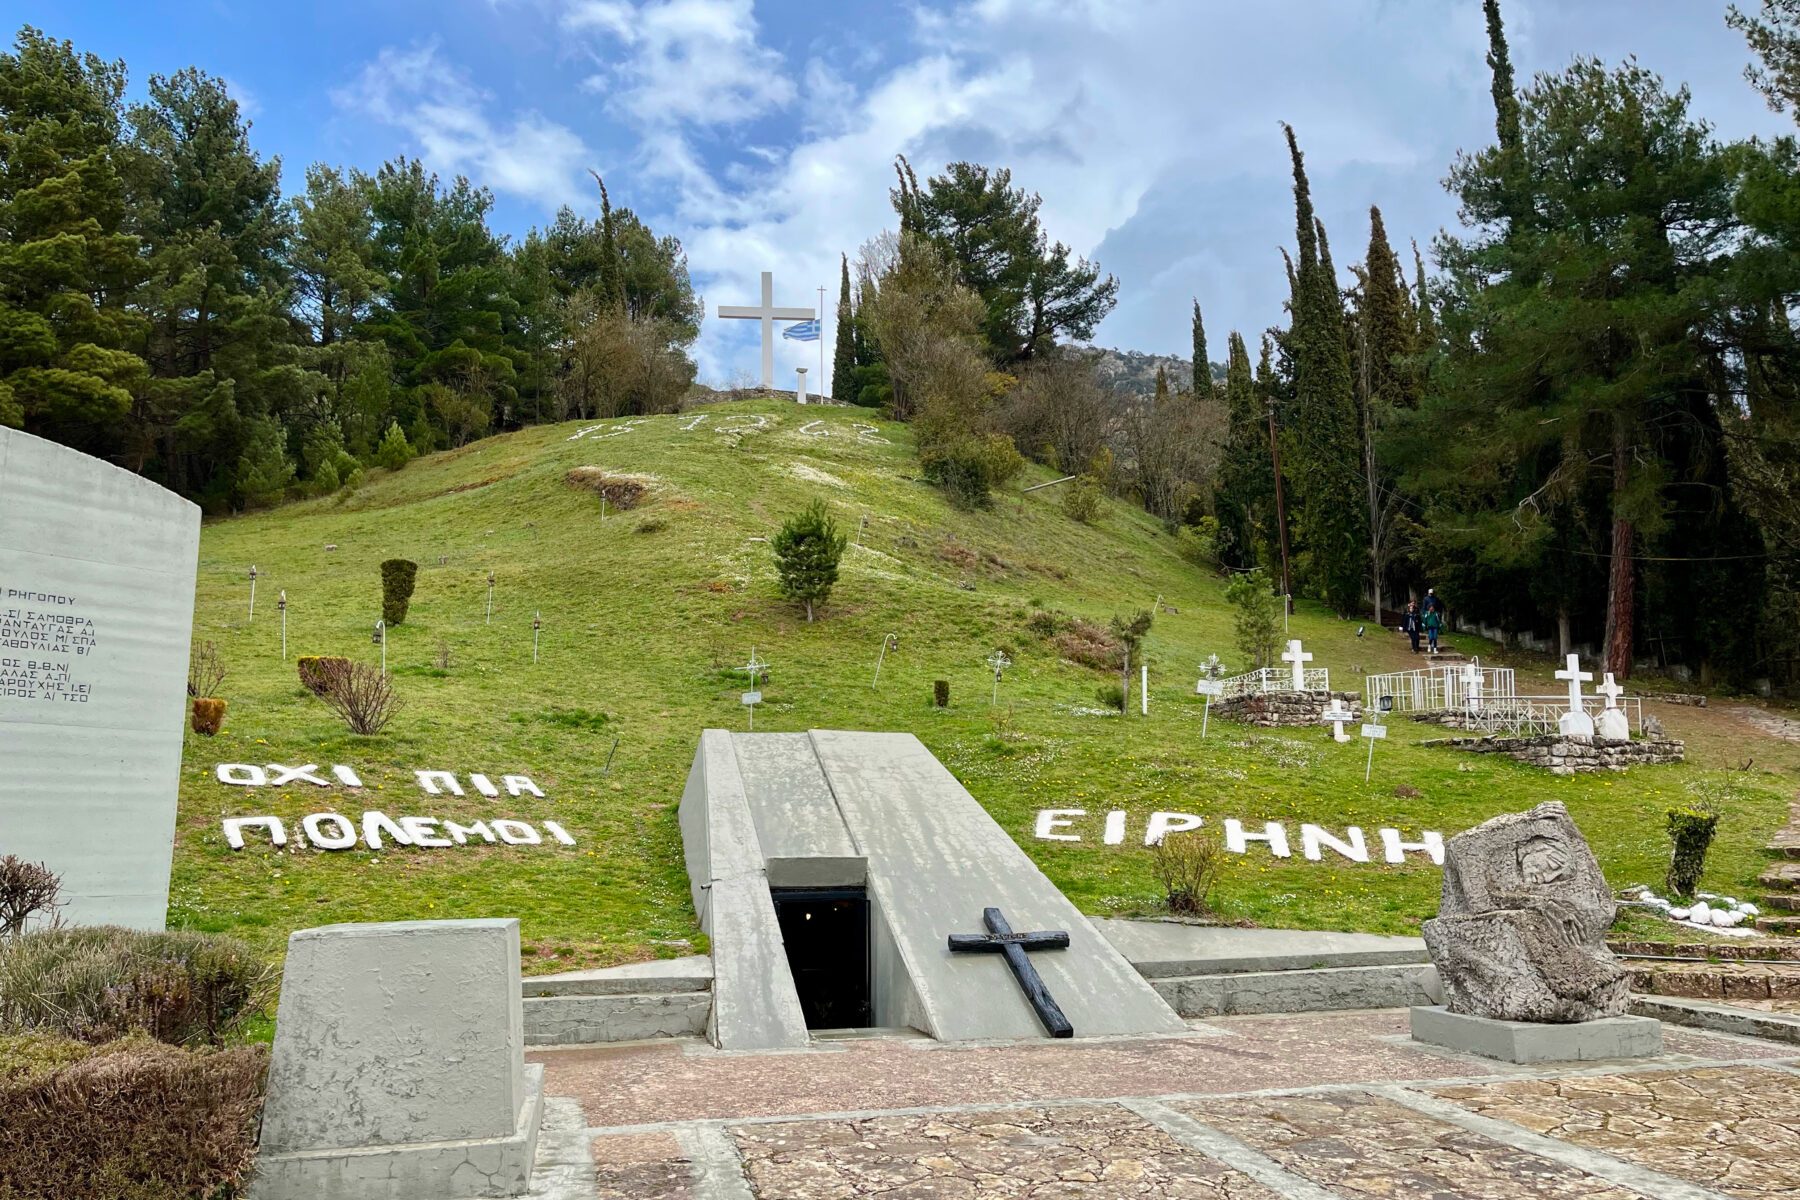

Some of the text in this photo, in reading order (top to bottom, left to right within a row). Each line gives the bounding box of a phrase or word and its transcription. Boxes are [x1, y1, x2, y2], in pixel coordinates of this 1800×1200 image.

[8, 589, 76, 605] ΡΗΓΟΠΟΥ
[0, 618, 74, 634] ΑΝΤΑΥΓΑΣ
[72, 636, 97, 647] ΣΠΑ
[62, 693, 89, 703] ΤΣΟ
[216, 763, 546, 797] ΟΧΙ ΠΙΑ
[222, 811, 577, 850] ΠΟΛΕΜΟΙ
[1034, 809, 1445, 866] ΕΙΡΗΝΗ
